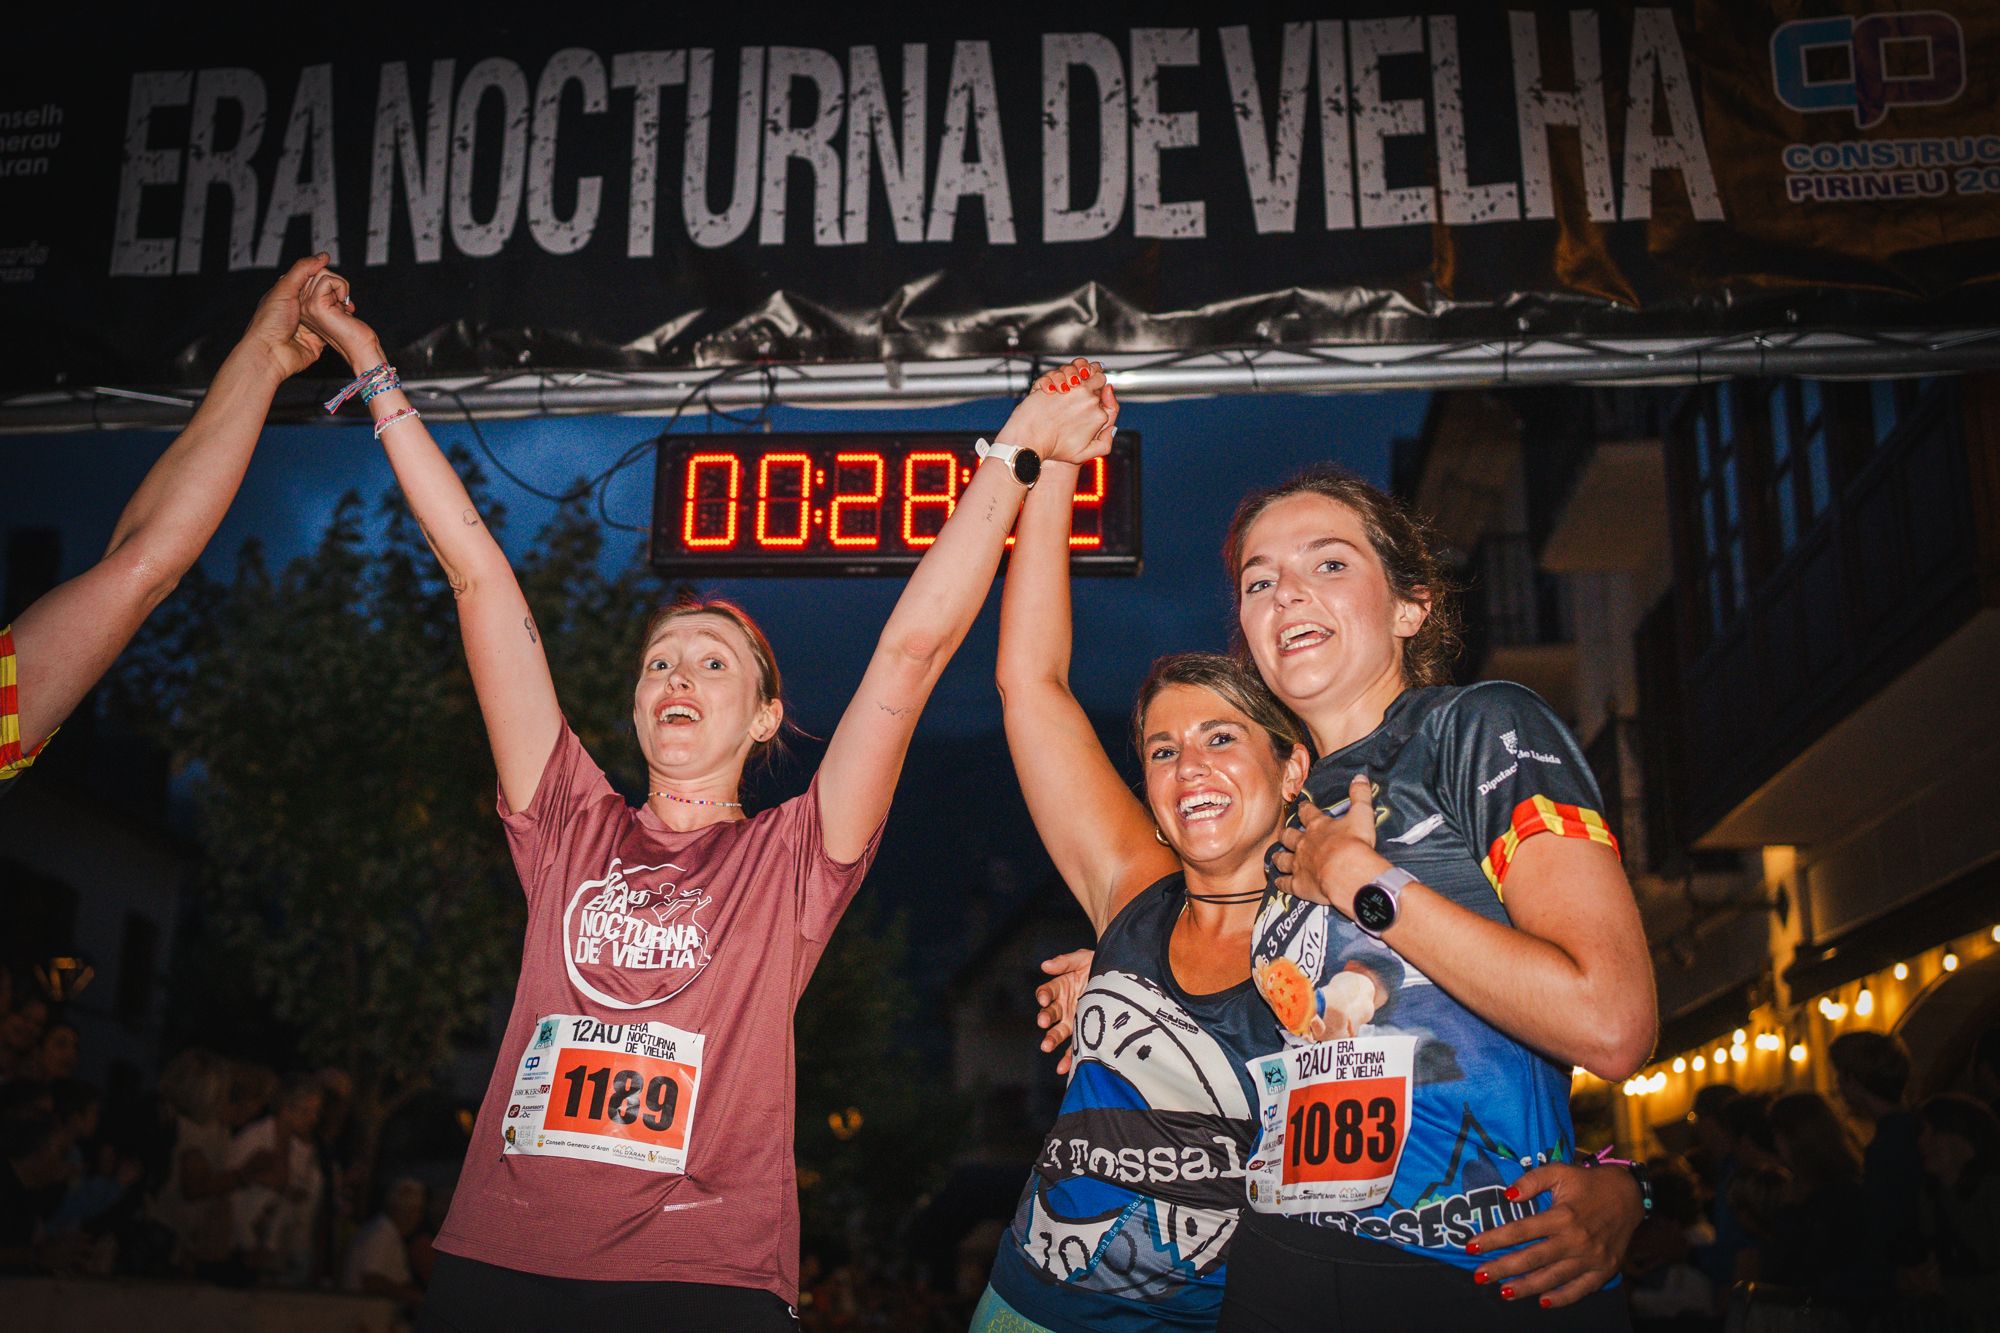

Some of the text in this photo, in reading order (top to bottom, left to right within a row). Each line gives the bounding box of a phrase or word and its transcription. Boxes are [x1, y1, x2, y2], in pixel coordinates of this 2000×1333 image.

[109, 5, 1725, 277] ERA NOCTURNA DE VIELHA
[1782, 135, 2000, 172] CONSTRUC
[1786, 168, 1949, 202] PIRINEU
[579, 910, 700, 950] NOCTURNA
[1276, 900, 1310, 941] Toss
[574, 936, 696, 969] DE VIELHA
[572, 1019, 623, 1044] 12AU
[627, 1031, 677, 1052] NOCTURNA
[629, 1022, 649, 1033] ERA
[625, 1042, 675, 1060] DE VIELHA
[1296, 1046, 1332, 1080] 12AU
[1336, 1051, 1385, 1067] NOCTURNA
[1337, 1040, 1354, 1053] ERA
[1336, 1065, 1384, 1080] DE VIELHA
[564, 1065, 678, 1132] 1189
[1290, 1097, 1396, 1167] 1083
